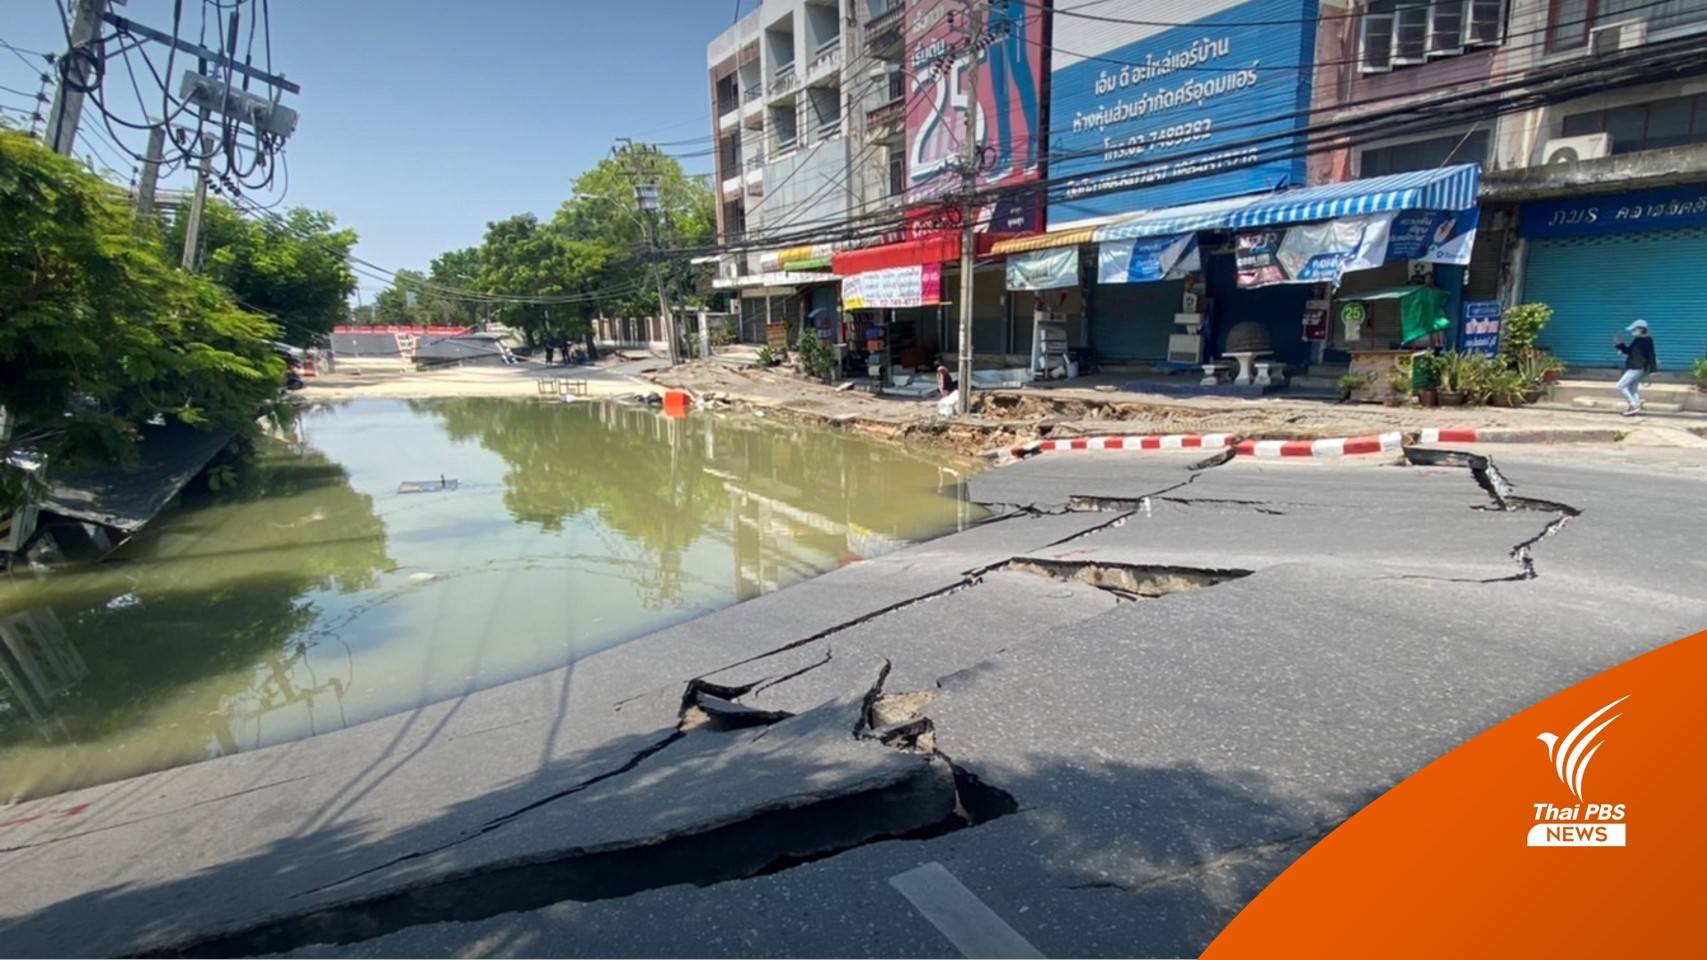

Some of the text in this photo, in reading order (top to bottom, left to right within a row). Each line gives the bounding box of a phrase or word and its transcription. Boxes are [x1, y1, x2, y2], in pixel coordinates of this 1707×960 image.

[912, 38, 945, 67] เริ่มต้น
[1095, 37, 1230, 95] เอ็ม ดี อะไหล่แอร์บ้าน
[1072, 59, 1260, 133] ห้างหุ้นส่วนจำกัดศรีอุดมแอร์
[1345, 306, 1361, 320] 25
